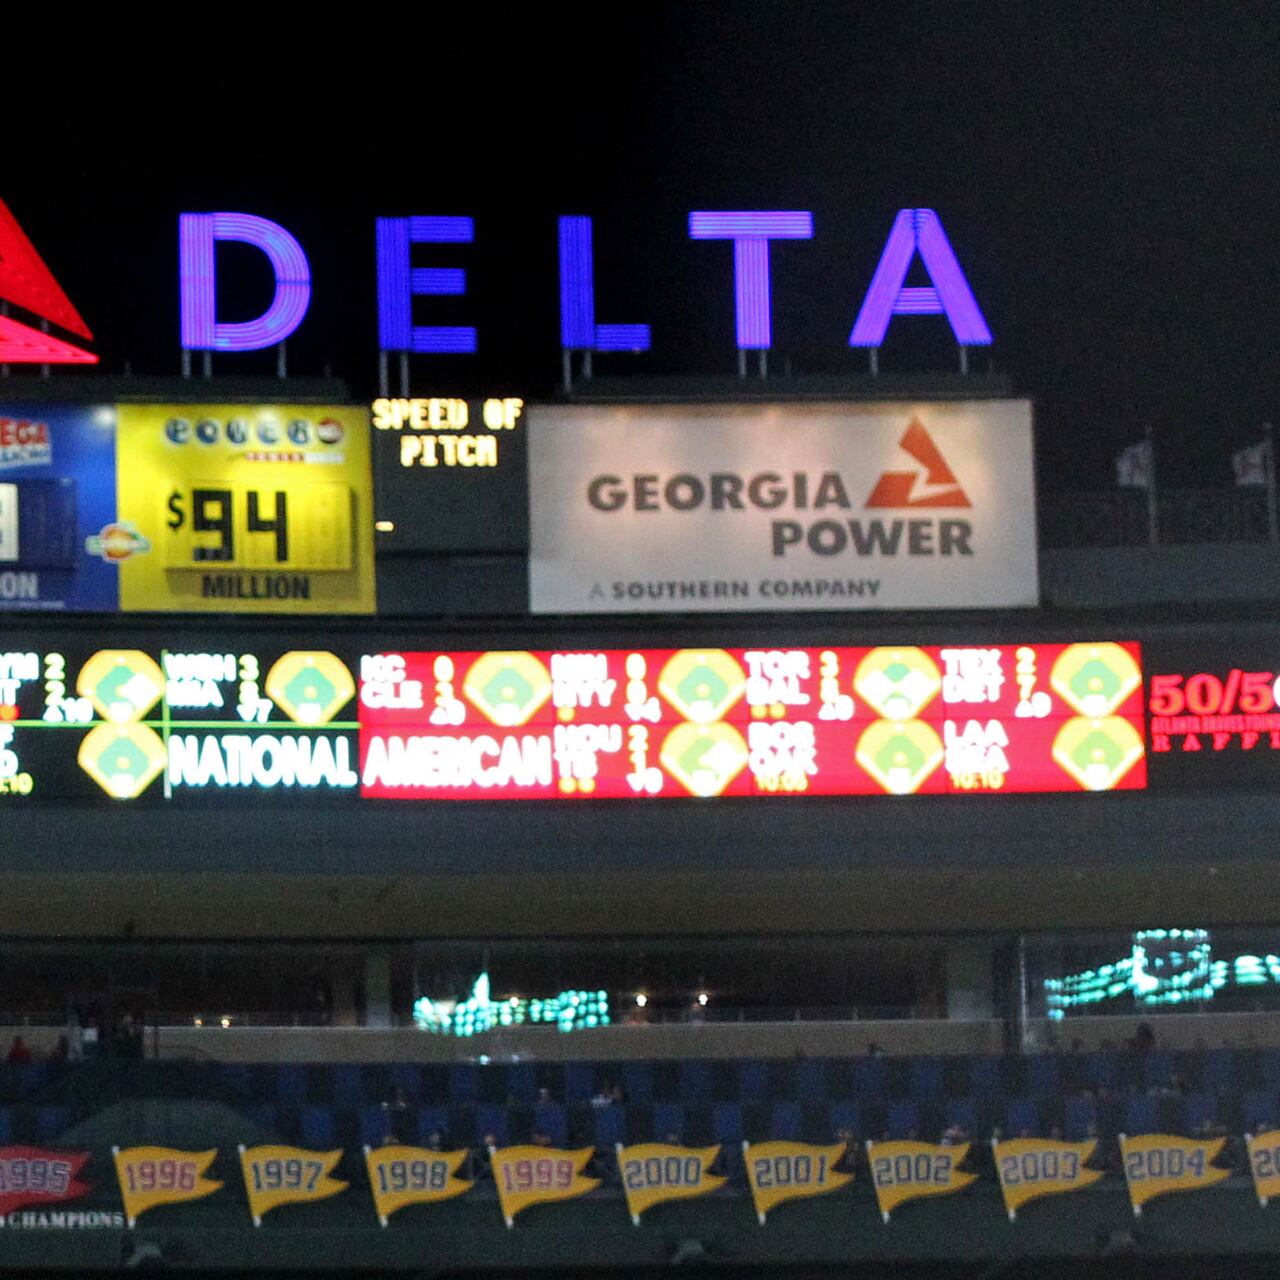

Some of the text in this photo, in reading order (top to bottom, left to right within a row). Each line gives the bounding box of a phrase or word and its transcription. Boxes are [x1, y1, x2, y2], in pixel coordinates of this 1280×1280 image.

[179, 208, 994, 353] DELTA
[372, 398, 523, 430] SPEED OF
[400, 435, 497, 467] PITCH
[587, 472, 852, 513] GEORGIA
[193, 490, 288, 562] 94
[771, 519, 975, 557] POWER
[202, 575, 311, 599] MILLION
[612, 580, 749, 601] SOUTHERN
[758, 577, 881, 599] COMPANY
[44, 652, 65, 680] 2
[238, 654, 259, 681] 3
[1016, 647, 1036, 674] 2
[44, 680, 65, 706] 2
[1016, 674, 1037, 700] 7
[1149, 668, 1280, 717] 50/5
[168, 735, 358, 787] NATIONAL
[362, 735, 552, 787] AMERICAN
[123, 1157, 197, 1194] 1996
[251, 1157, 323, 1193] 1997
[376, 1157, 448, 1194] 1998
[502, 1157, 575, 1194] 1999
[624, 1154, 703, 1191] 2000
[754, 1153, 829, 1188] 2001
[873, 1152, 953, 1187] 2002
[999, 1150, 1080, 1185] 2003
[1126, 1147, 1209, 1183] 2004
[8, 1211, 124, 1229] CHAMPIONS
